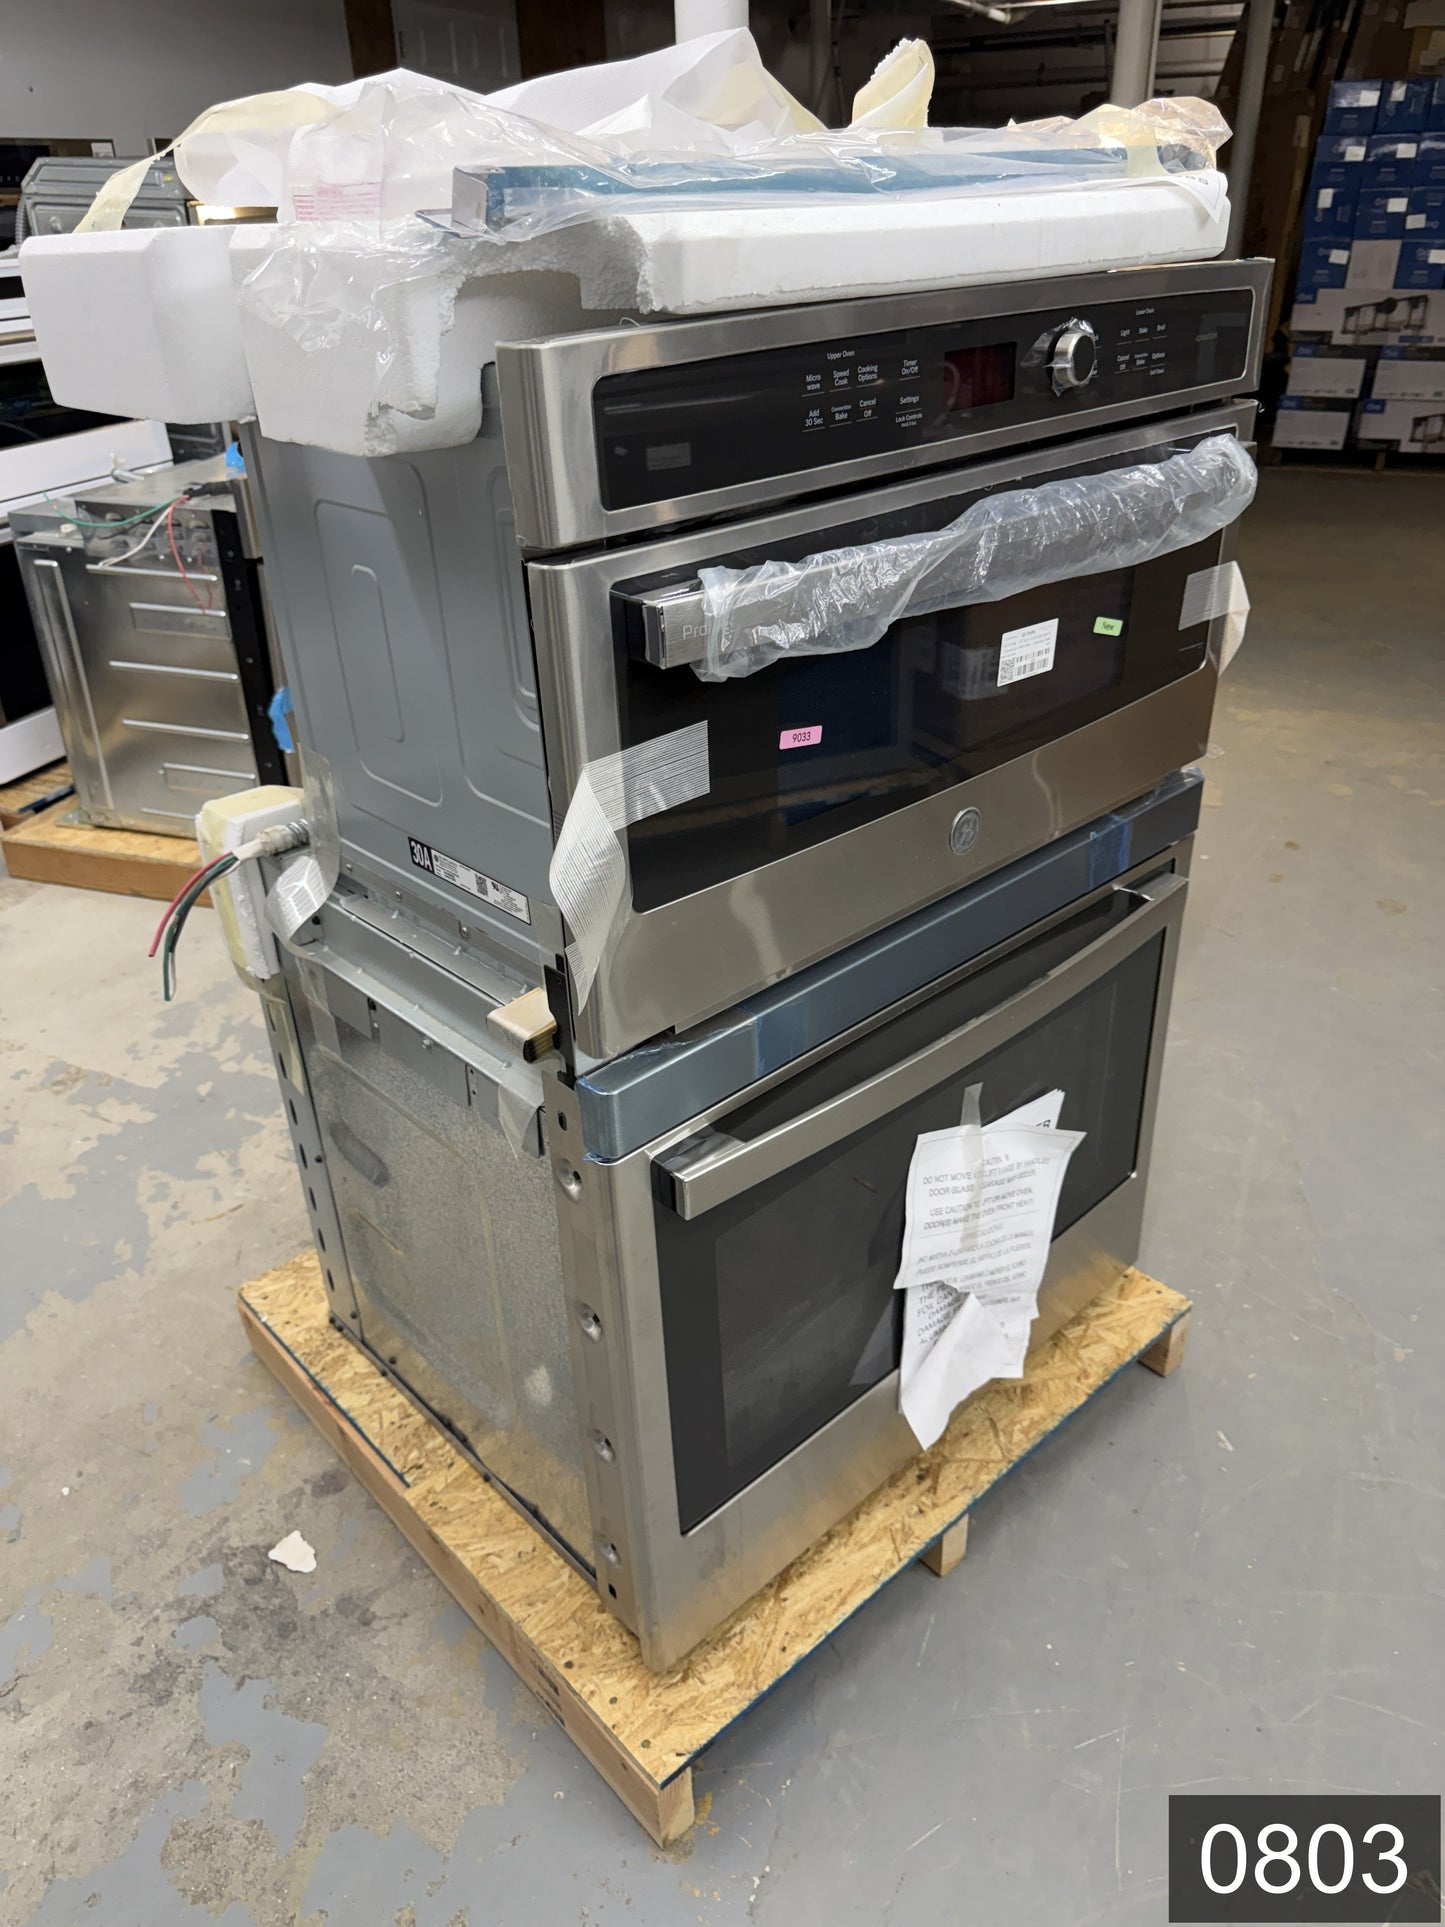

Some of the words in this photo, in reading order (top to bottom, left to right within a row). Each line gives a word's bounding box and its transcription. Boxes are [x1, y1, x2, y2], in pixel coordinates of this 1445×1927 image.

[842, 350, 855, 358] Oven
[833, 369, 849, 378] Speed
[858, 365, 878, 373] Cooking
[902, 367, 918, 375] On/Off
[806, 374, 821, 382] Micro
[835, 378, 847, 386] Cook
[858, 373, 877, 382] Options
[860, 398, 876, 407] Cancel
[900, 396, 919, 405] Settings
[809, 409, 819, 417] Add
[864, 410, 872, 418] Off
[805, 418, 813, 426] 30
[814, 417, 823, 425] Sec
[792, 731, 811, 743] 9033
[410, 840, 433, 871] 30A
[922, 1176, 933, 1185] DO
[934, 1174, 949, 1183] NOT
[950, 1171, 972, 1181] MOVE
[928, 1188, 950, 1197] DOOR
[951, 1183, 975, 1194] GLASS
[929, 1207, 943, 1217] USE
